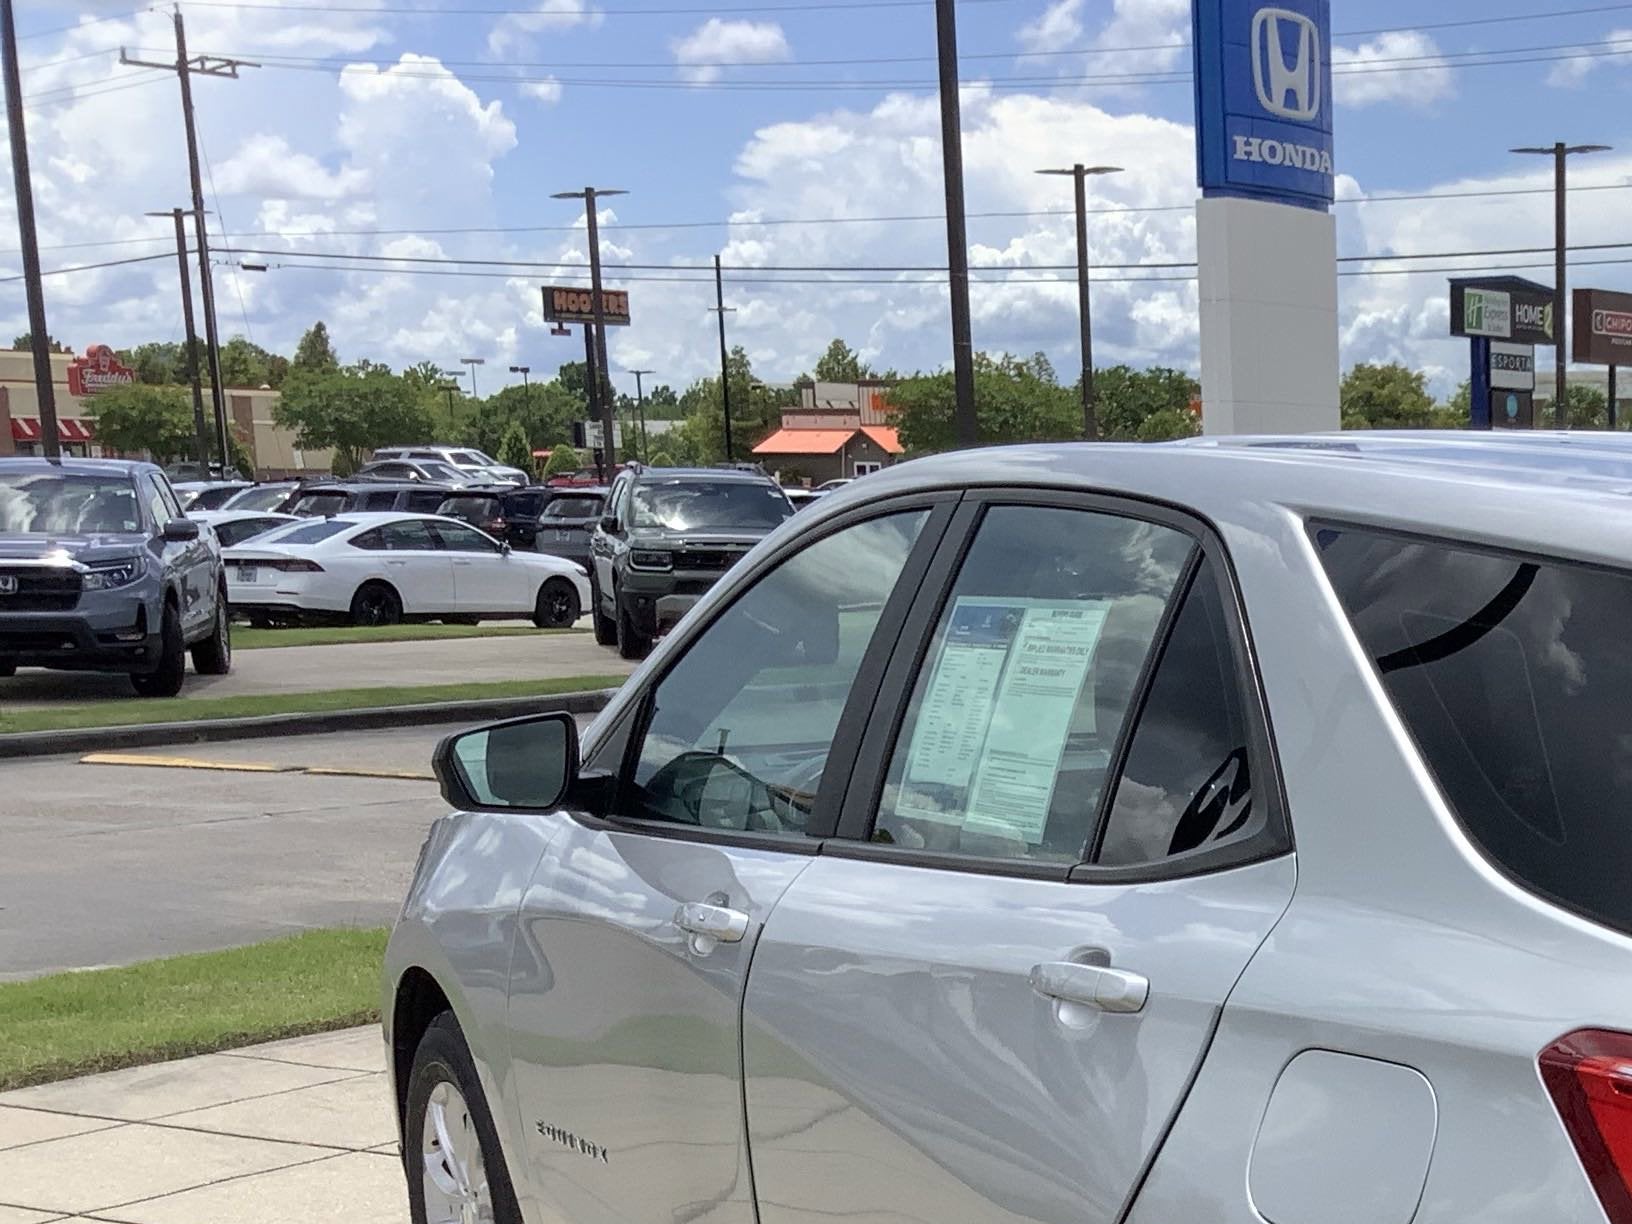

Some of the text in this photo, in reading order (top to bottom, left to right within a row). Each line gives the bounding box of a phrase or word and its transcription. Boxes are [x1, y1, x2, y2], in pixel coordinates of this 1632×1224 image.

[1233, 134, 1334, 174] HONDA
[553, 289, 628, 315] HOOERS
[1491, 353, 1533, 369] ESPORTA
